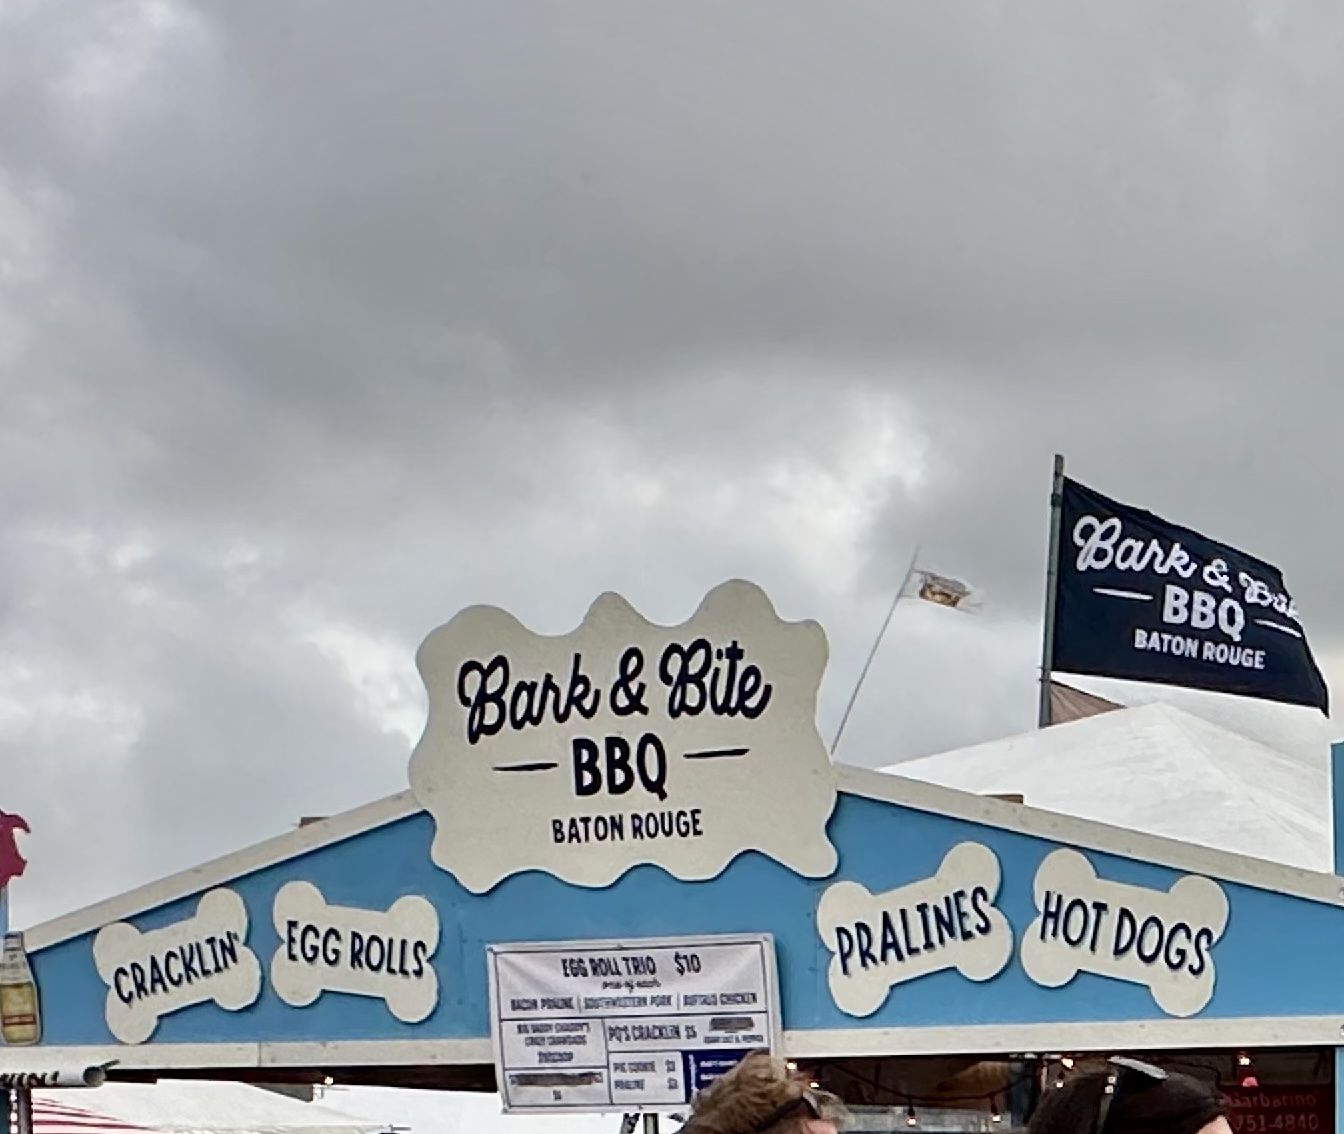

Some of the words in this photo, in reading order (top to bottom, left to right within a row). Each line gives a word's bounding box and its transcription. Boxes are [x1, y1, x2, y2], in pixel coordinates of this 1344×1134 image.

[1072, 514, 1198, 578] Bark
[1202, 558, 1233, 593] &
[1162, 584, 1246, 643] BBQ
[1134, 628, 1199, 660] BATON
[1202, 641, 1267, 670] ROUGE
[457, 653, 601, 746] Bark
[609, 645, 650, 716] &
[658, 637, 772, 719] Bite
[571, 732, 669, 801] BBQ
[552, 814, 625, 844] BATON
[631, 808, 704, 840] ROUGE
[286, 919, 342, 968] EGG
[349, 928, 429, 979] ROLLS
[834, 886, 993, 976] PRALINES
[1039, 889, 1112, 948] HOT
[1112, 906, 1214, 977] DOGS
[561, 957, 589, 978] EGG
[590, 956, 622, 977] ROLL
[621, 955, 656, 976] TRIO
[674, 951, 702, 976] $10
